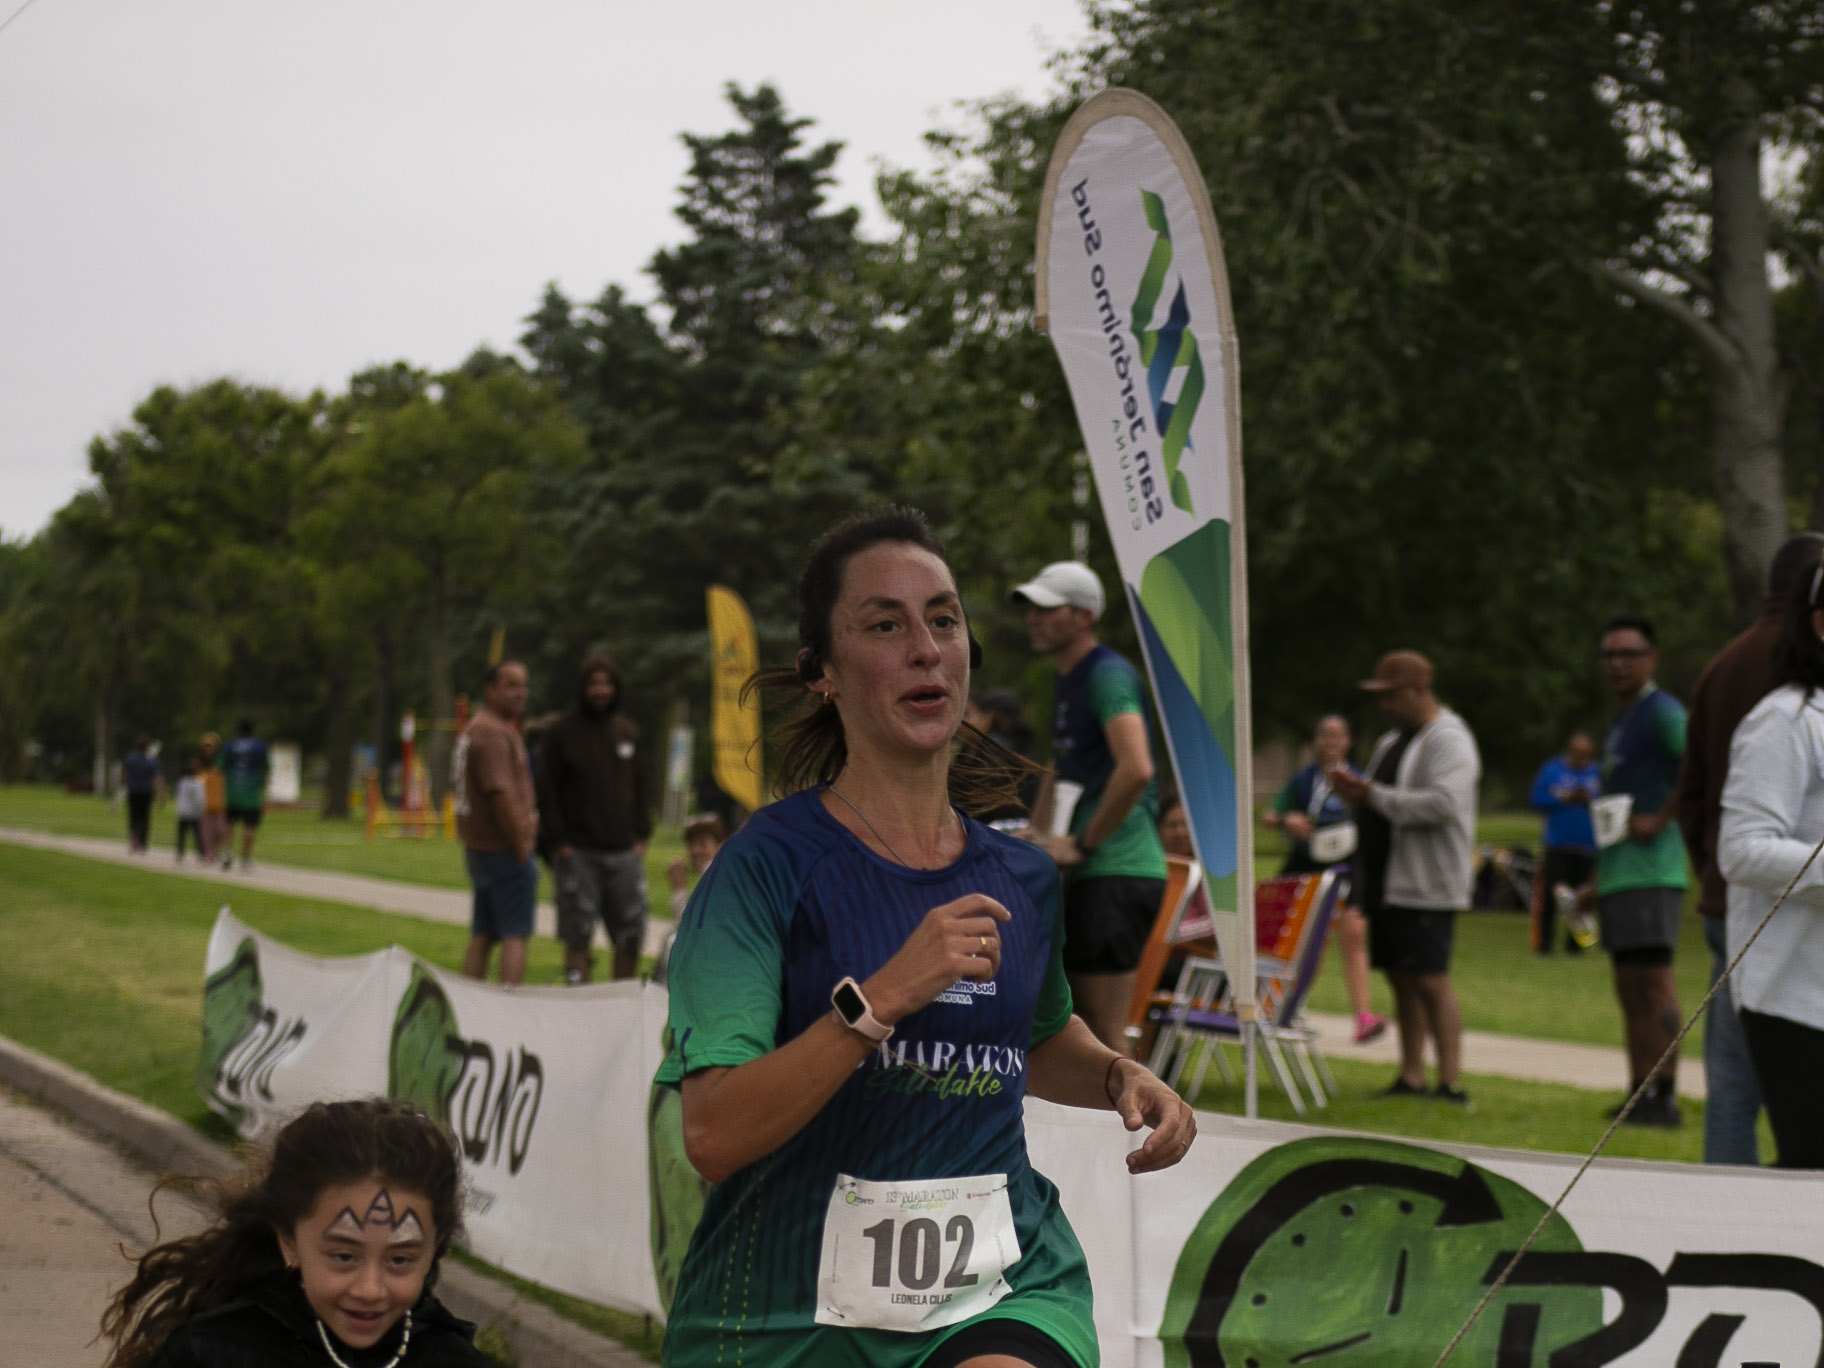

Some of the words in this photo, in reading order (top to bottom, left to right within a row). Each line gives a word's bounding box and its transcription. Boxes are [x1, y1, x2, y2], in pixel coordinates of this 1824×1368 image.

[976, 981, 995, 994] Sud
[874, 1040, 1025, 1077] MARATON
[863, 1214, 980, 1291] 102
[891, 1293, 928, 1306] LEONELA
